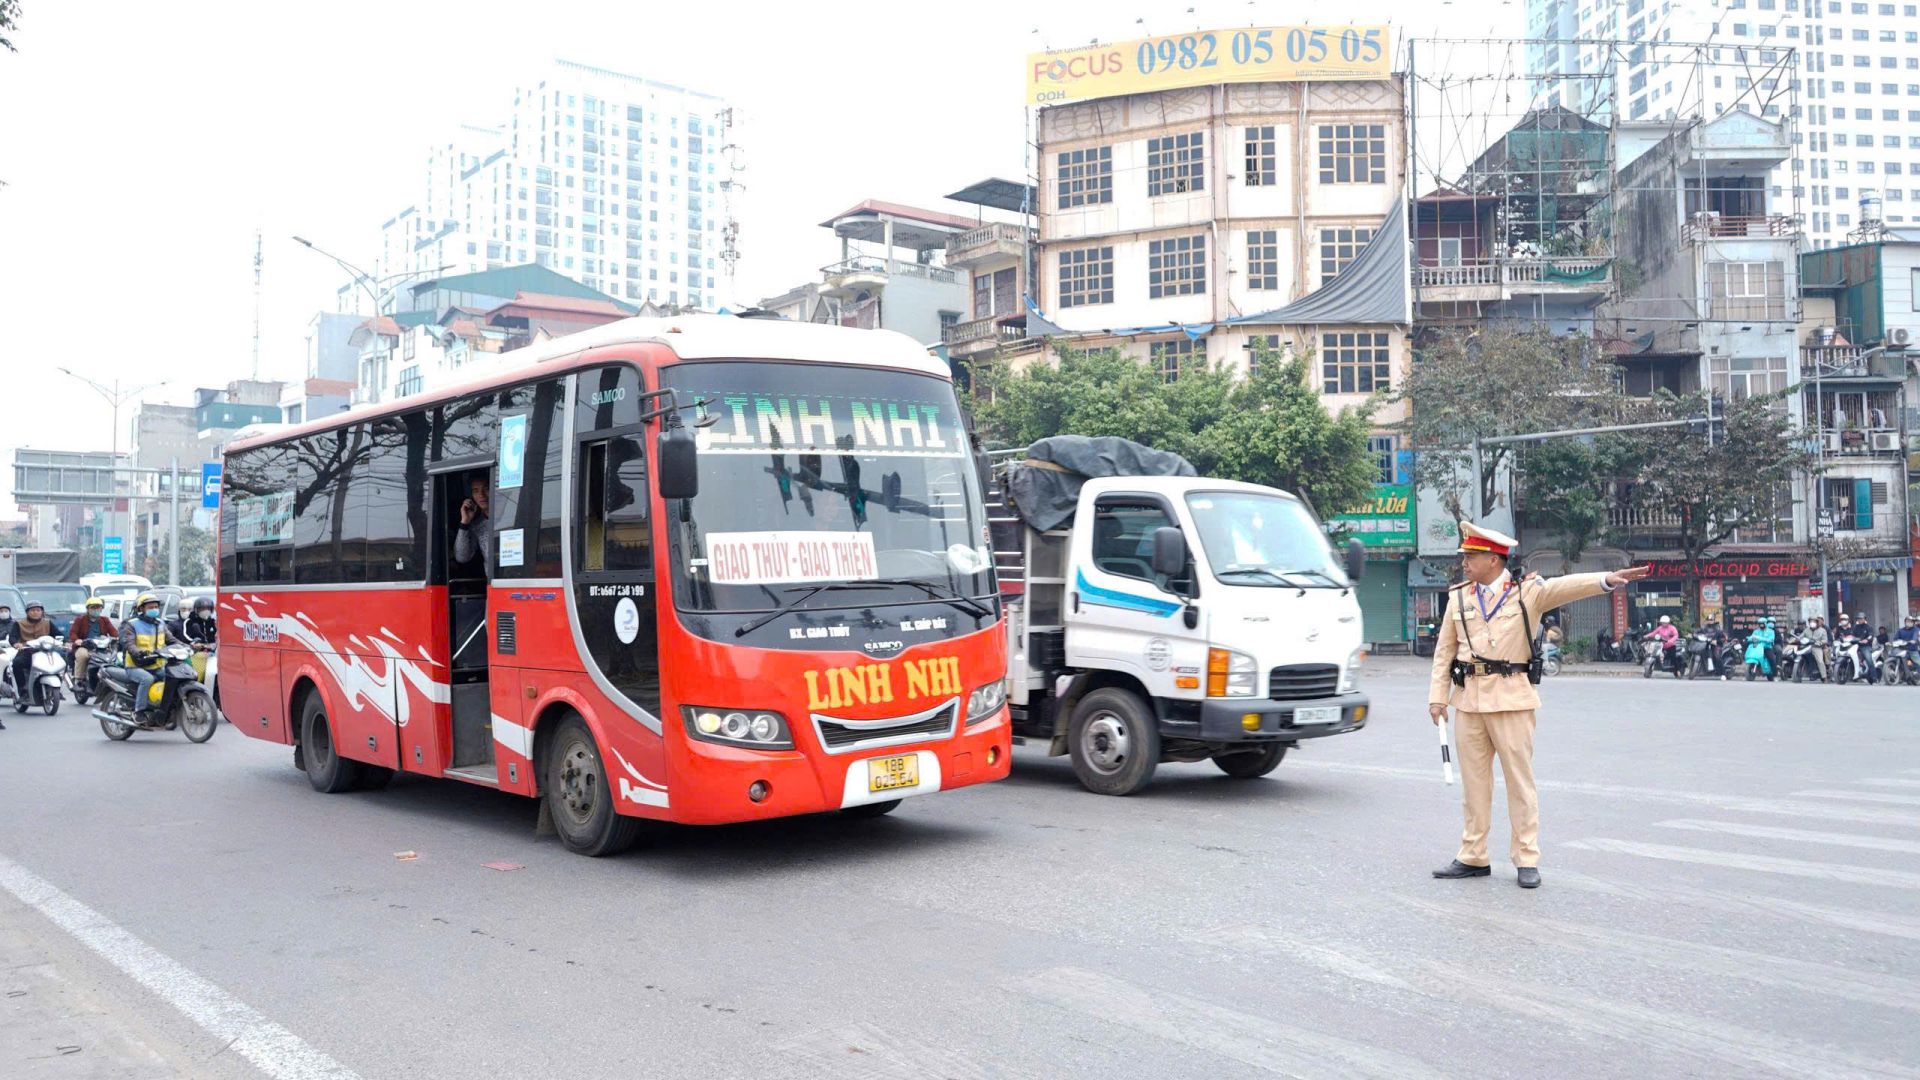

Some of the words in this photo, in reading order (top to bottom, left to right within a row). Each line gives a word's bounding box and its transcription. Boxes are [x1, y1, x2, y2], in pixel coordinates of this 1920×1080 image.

[1136, 32, 1219, 76] 0982
[1231, 29, 1274, 65] 05
[1286, 28, 1328, 63] 05
[1340, 28, 1382, 63] 05
[1034, 51, 1123, 84] FOCUS
[1036, 89, 1066, 102] OOH
[591, 387, 626, 406] SAMCO
[694, 396, 835, 447] LINH
[851, 401, 946, 448] NHI
[713, 542, 751, 581] GIAO
[798, 541, 831, 577] GIAO
[1703, 563, 1760, 577] ICLOUD
[807, 627, 828, 639] GIAO
[864, 640, 904, 652] SAMCO
[803, 662, 895, 711] LINH
[903, 656, 964, 700] NHI
[884, 758, 904, 773] 18B
